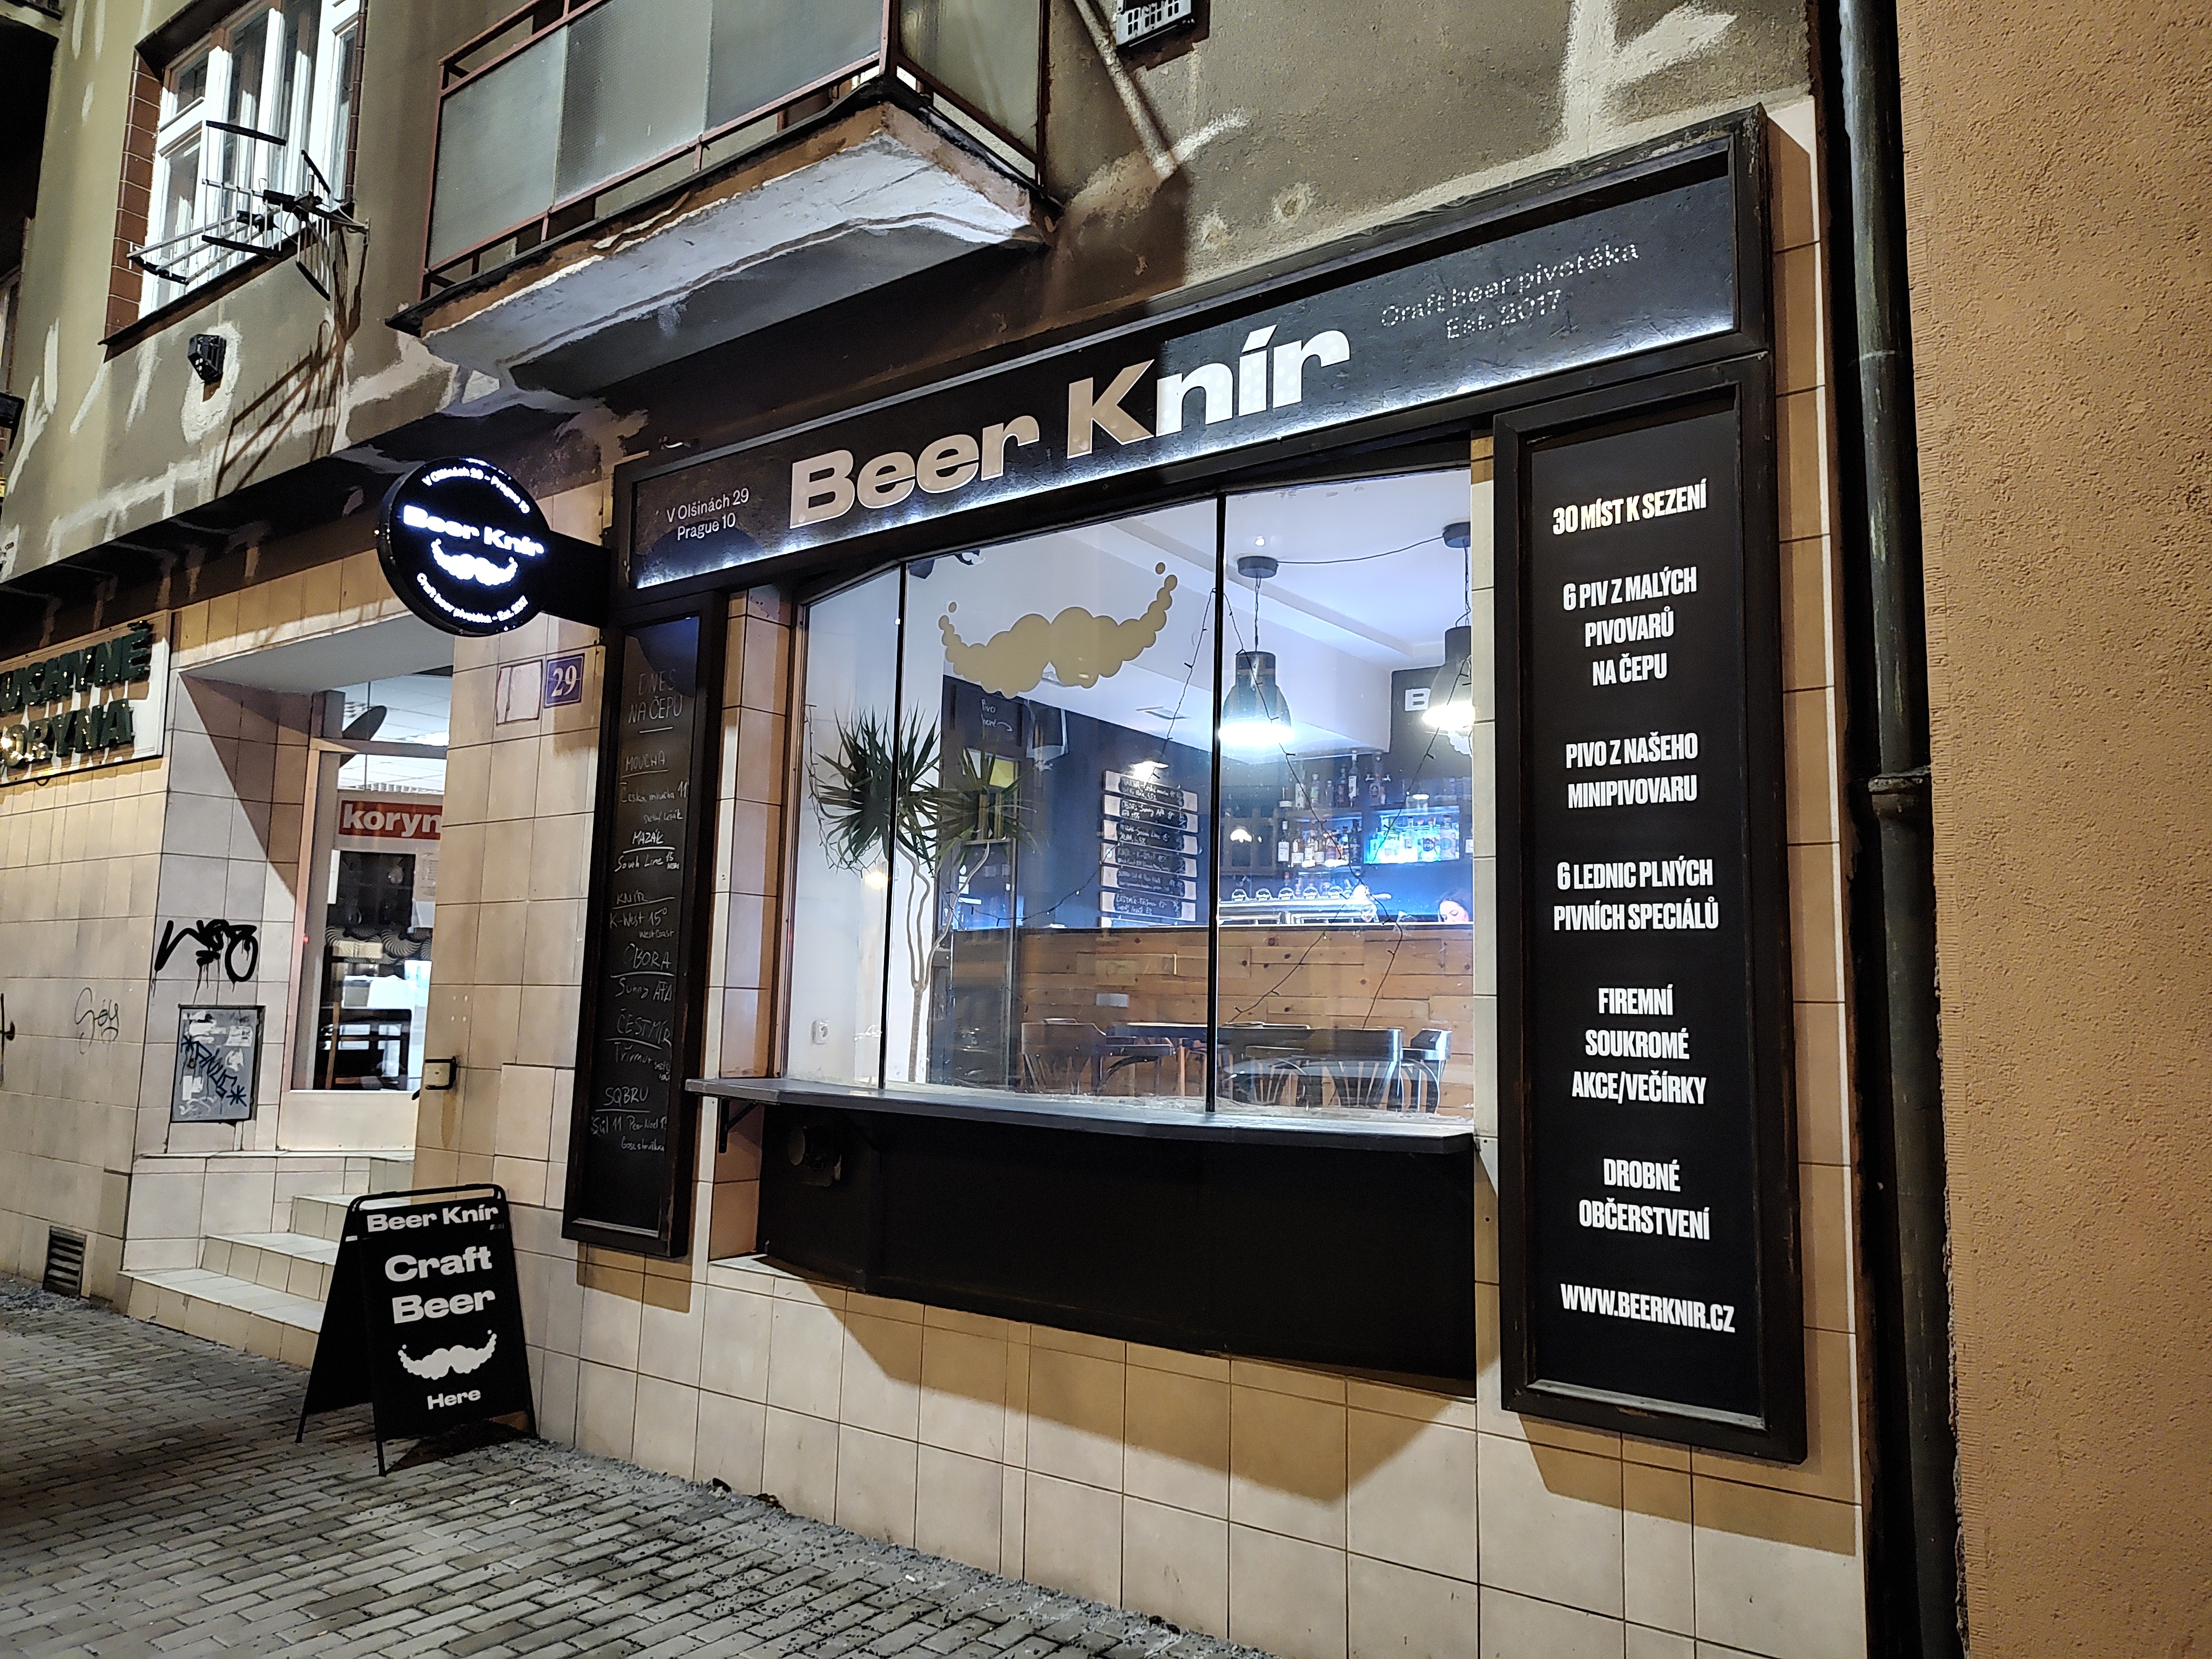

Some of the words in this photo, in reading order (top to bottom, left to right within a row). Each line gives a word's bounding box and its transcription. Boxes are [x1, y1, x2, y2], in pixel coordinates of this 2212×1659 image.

[1381, 294, 1445, 326] Craft
[1501, 289, 1561, 326] 2017
[790, 415, 1040, 528] Beer
[1067, 325, 1350, 459] Knír
[666, 507, 675, 523] V
[678, 494, 730, 520] Olšinách
[732, 488, 749, 505] 29
[1553, 505, 1578, 535] 30
[1581, 498, 1624, 530] MÍST
[1627, 495, 1640, 522] K
[1642, 478, 1707, 518] SEZENÍ
[677, 521, 719, 541] Prague
[722, 512, 736, 529] 10
[1563, 583, 1577, 611] 6
[1580, 581, 1608, 609] PIV
[1610, 578, 1623, 604] Z
[1625, 567, 1697, 602] MALÝCH
[1585, 606, 1674, 647] PIVOVARŮ
[0, 620, 150, 716] UCHYNĚ
[551, 665, 577, 697] 29
[639, 669, 676, 696] DNES
[1593, 659, 1616, 686] NA
[1619, 653, 1668, 683] ČEPU
[628, 702, 646, 724] NA
[649, 695, 683, 719] ČEPU
[981, 699, 996, 713] Pivo
[0, 698, 133, 767] ORYNA
[625, 750, 665, 771] MOUCHA
[1566, 741, 1607, 768] PIVO
[1609, 739, 1622, 765] Z
[1624, 732, 1698, 764] NAŠEHO
[1568, 774, 1697, 808] MINIPIVOVARU
[343, 803, 441, 837] koryn
[632, 828, 664, 846] MAZÁK
[1557, 862, 1571, 890] 6
[1574, 862, 1636, 889] LEDNIC
[1639, 855, 1713, 887] PLNÝCH
[616, 889, 648, 905] KNÍR
[1554, 900, 1625, 930] PIVNÍCH
[1627, 896, 1719, 930] SPECIÁLŮ
[624, 943, 672, 970] OBORA
[1599, 984, 1674, 1015] FIREMNÍ
[1585, 1028, 1690, 1059] SOUKROMÉ
[1572, 1070, 1707, 1104] AKCE/VEČÍRKY
[1603, 1158, 1681, 1192] DROBNÉ
[367, 1212, 437, 1233] Beer
[442, 1204, 499, 1225] Knír
[1579, 1197, 1710, 1240] OBČERSTVENÍ
[385, 1246, 493, 1282] Craft
[392, 1290, 496, 1324] Beer
[1560, 1283, 1735, 1333] WWW.BEERKNIR.CZ
[427, 1390, 481, 1410] Here
